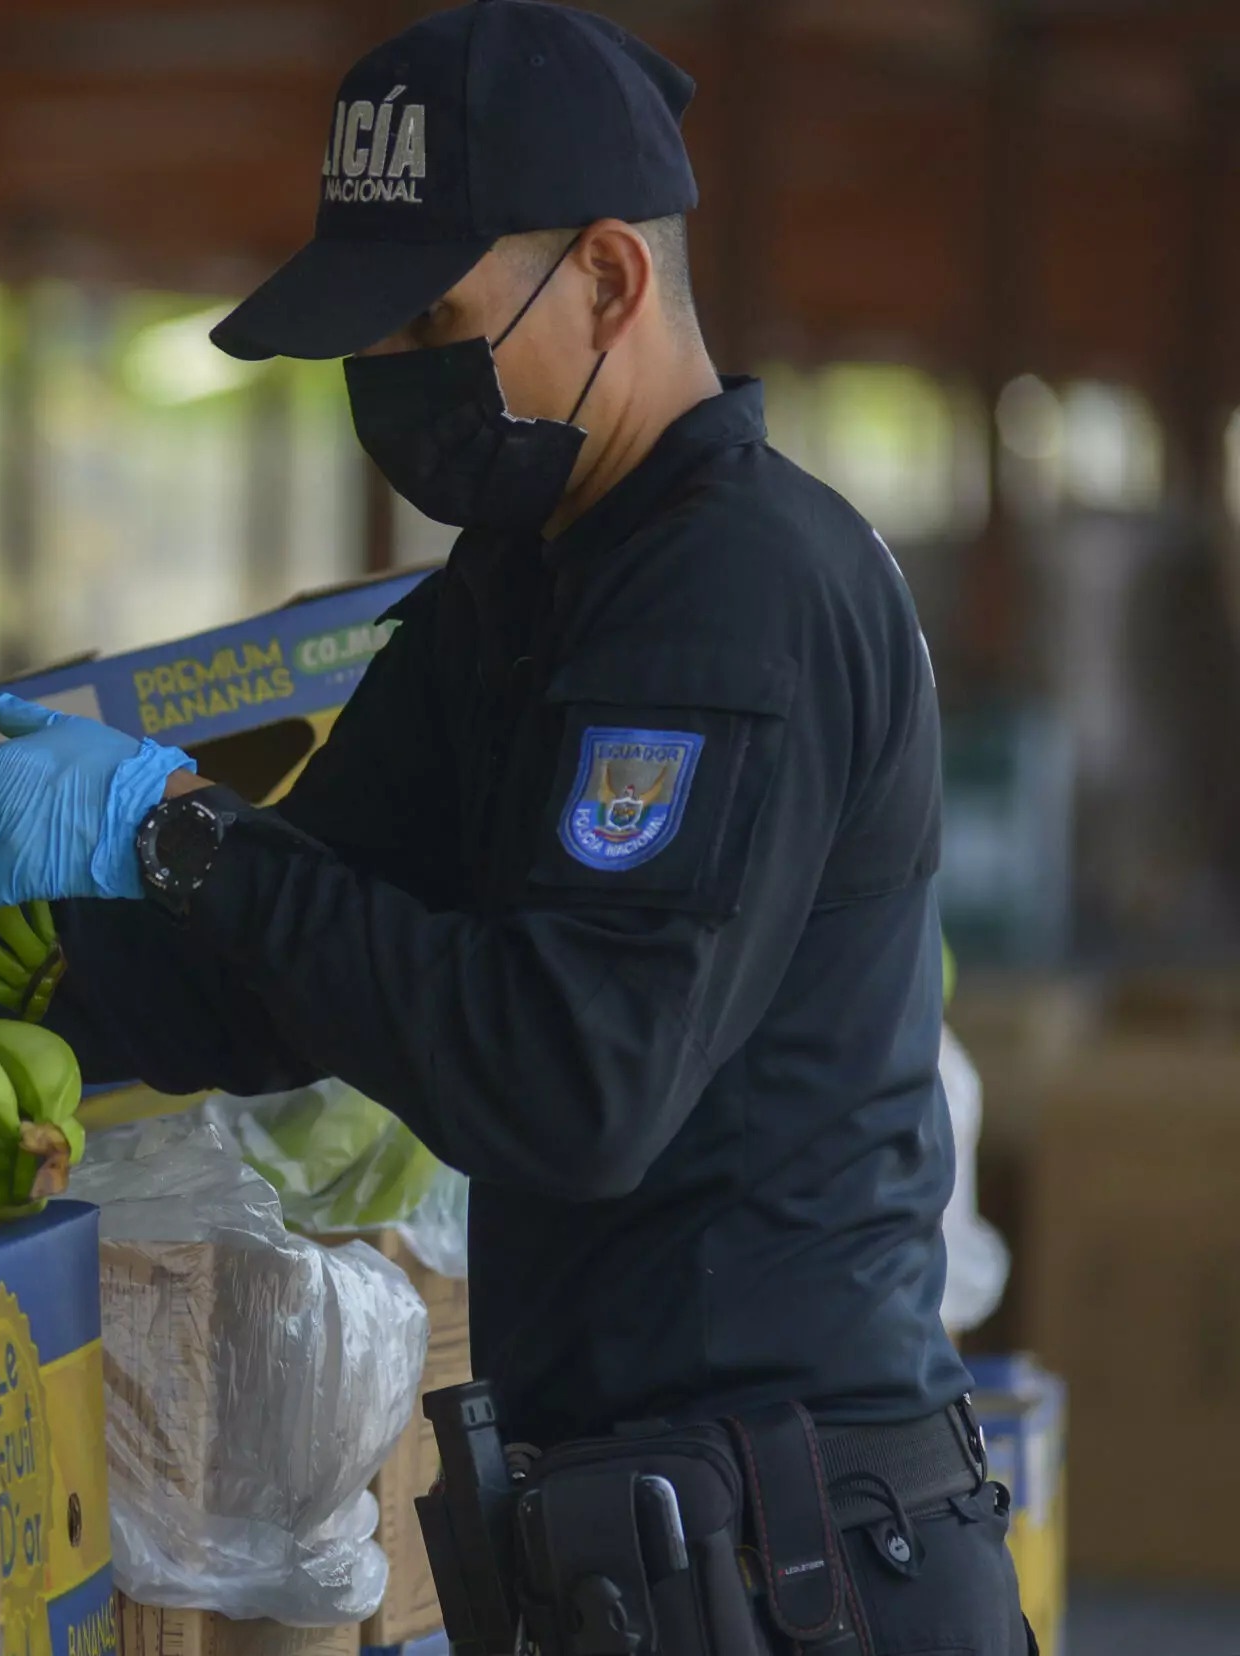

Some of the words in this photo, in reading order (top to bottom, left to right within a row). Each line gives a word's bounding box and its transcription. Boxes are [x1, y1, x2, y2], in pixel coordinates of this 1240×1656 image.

[325, 178, 423, 203] NACIONAL
[133, 637, 283, 701] PREMIUM
[139, 667, 295, 736] BANANAS
[598, 744, 680, 763] ECUADOR
